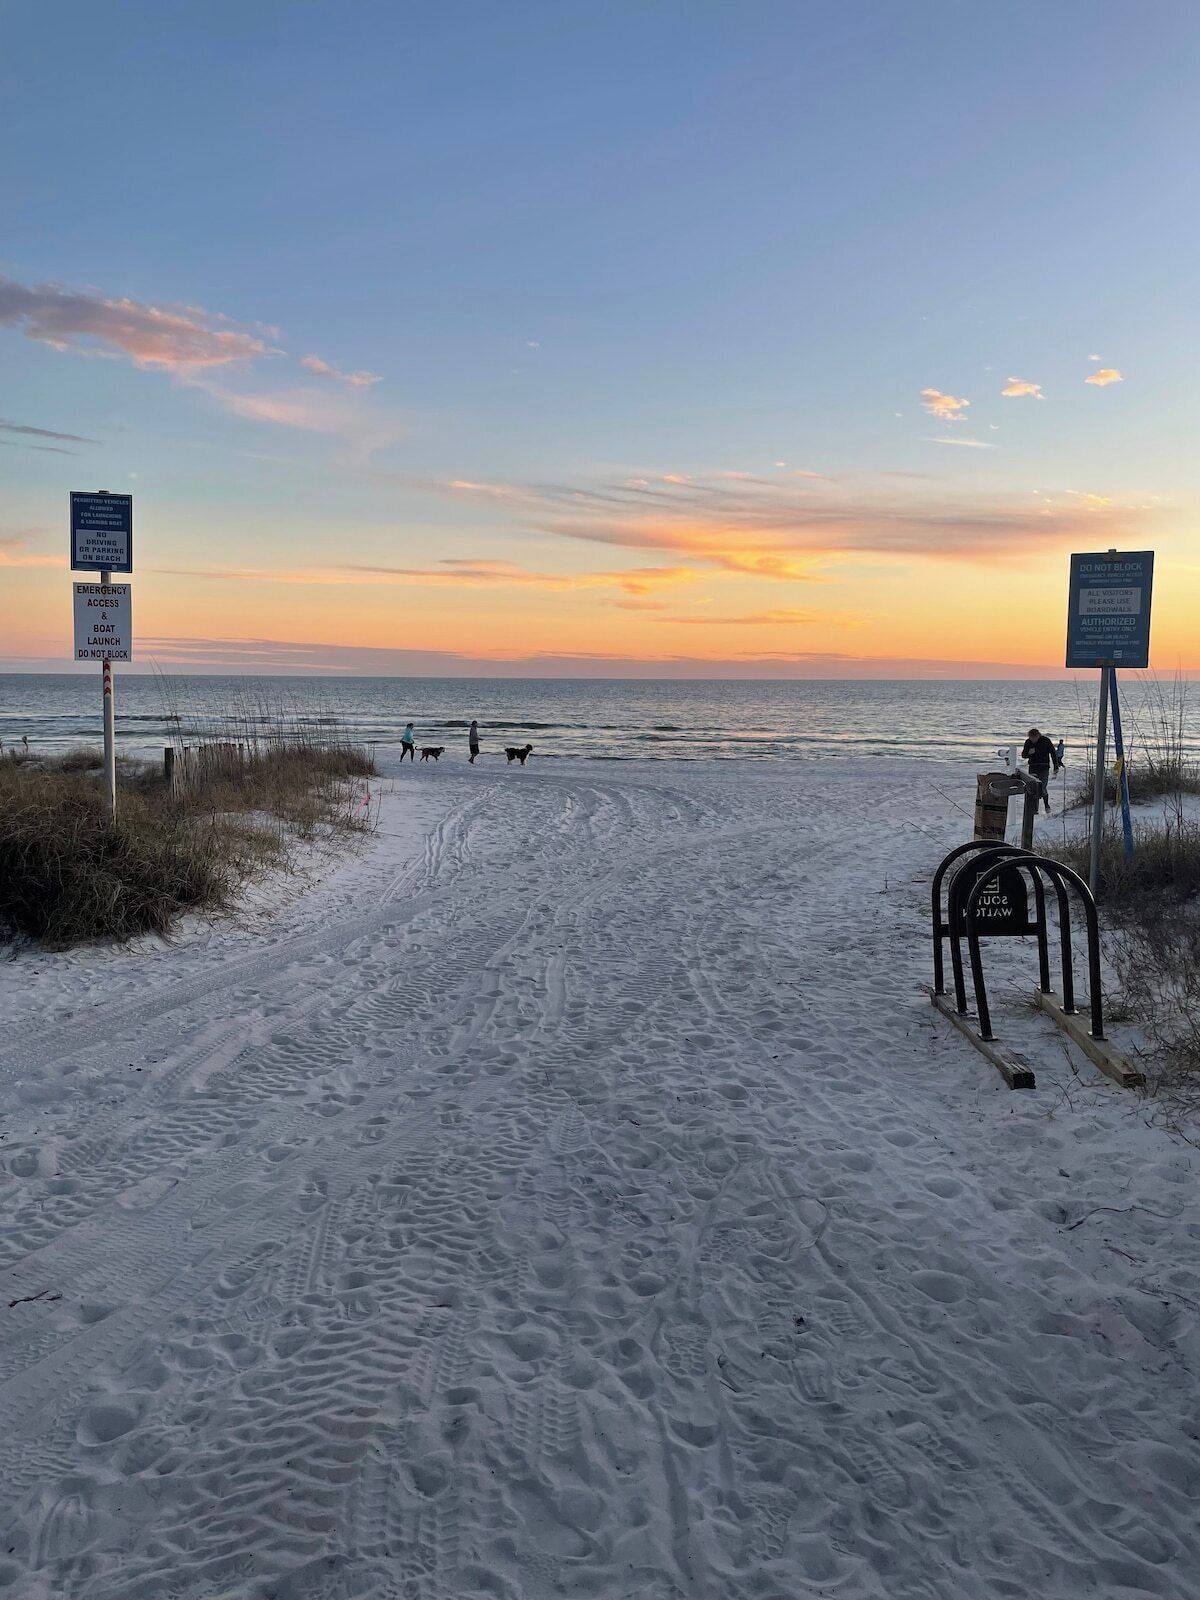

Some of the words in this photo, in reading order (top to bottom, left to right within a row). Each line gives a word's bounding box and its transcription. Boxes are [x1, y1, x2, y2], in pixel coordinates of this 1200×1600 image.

[1080, 564, 1092, 572] DO
[1094, 563, 1112, 571] NOT
[1114, 562, 1142, 571] BLOCK
[77, 586, 127, 594] EMERGENCY
[88, 599, 119, 607] ACCESS
[101, 612, 108, 620] &
[1081, 618, 1136, 626] AUTHORIZED
[88, 637, 120, 645] LAUNCH
[79, 649, 88, 658] DO
[91, 650, 105, 658] NOT
[108, 650, 128, 658] BLOCK
